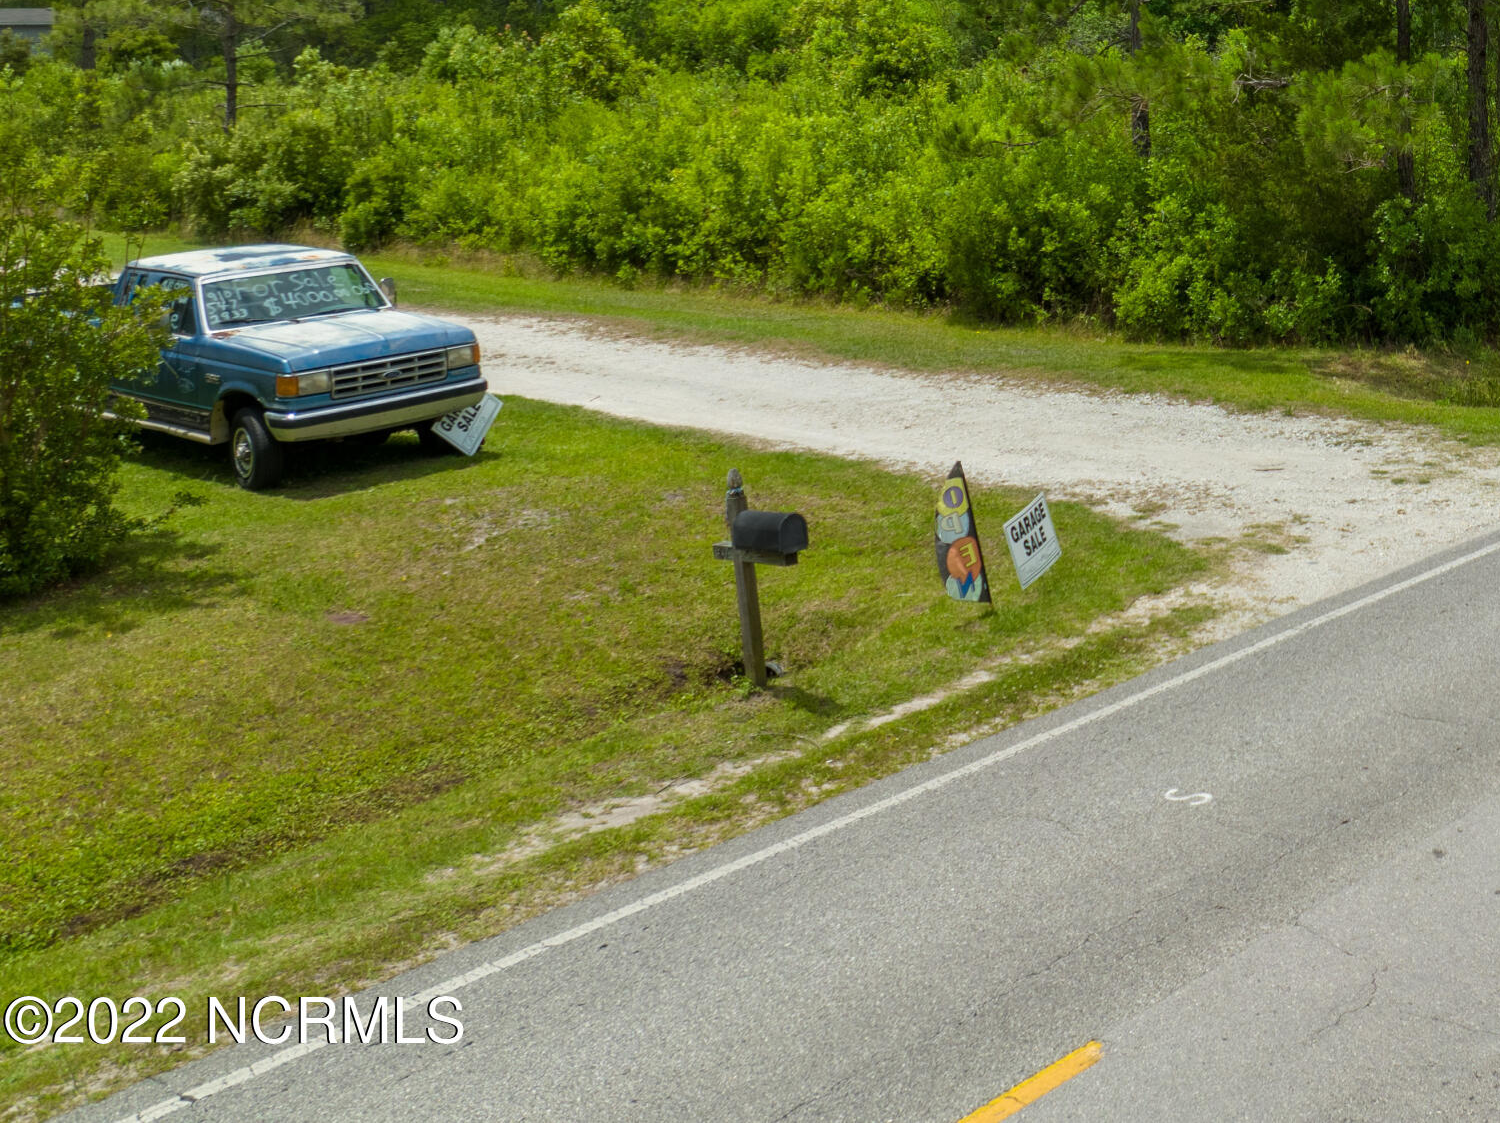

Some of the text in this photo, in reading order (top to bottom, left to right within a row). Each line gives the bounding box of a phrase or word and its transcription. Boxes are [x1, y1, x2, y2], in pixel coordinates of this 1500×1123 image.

[231, 271, 345, 301] For Sale
[1010, 501, 1047, 544] GARAGE
[1023, 525, 1047, 557] SALE
